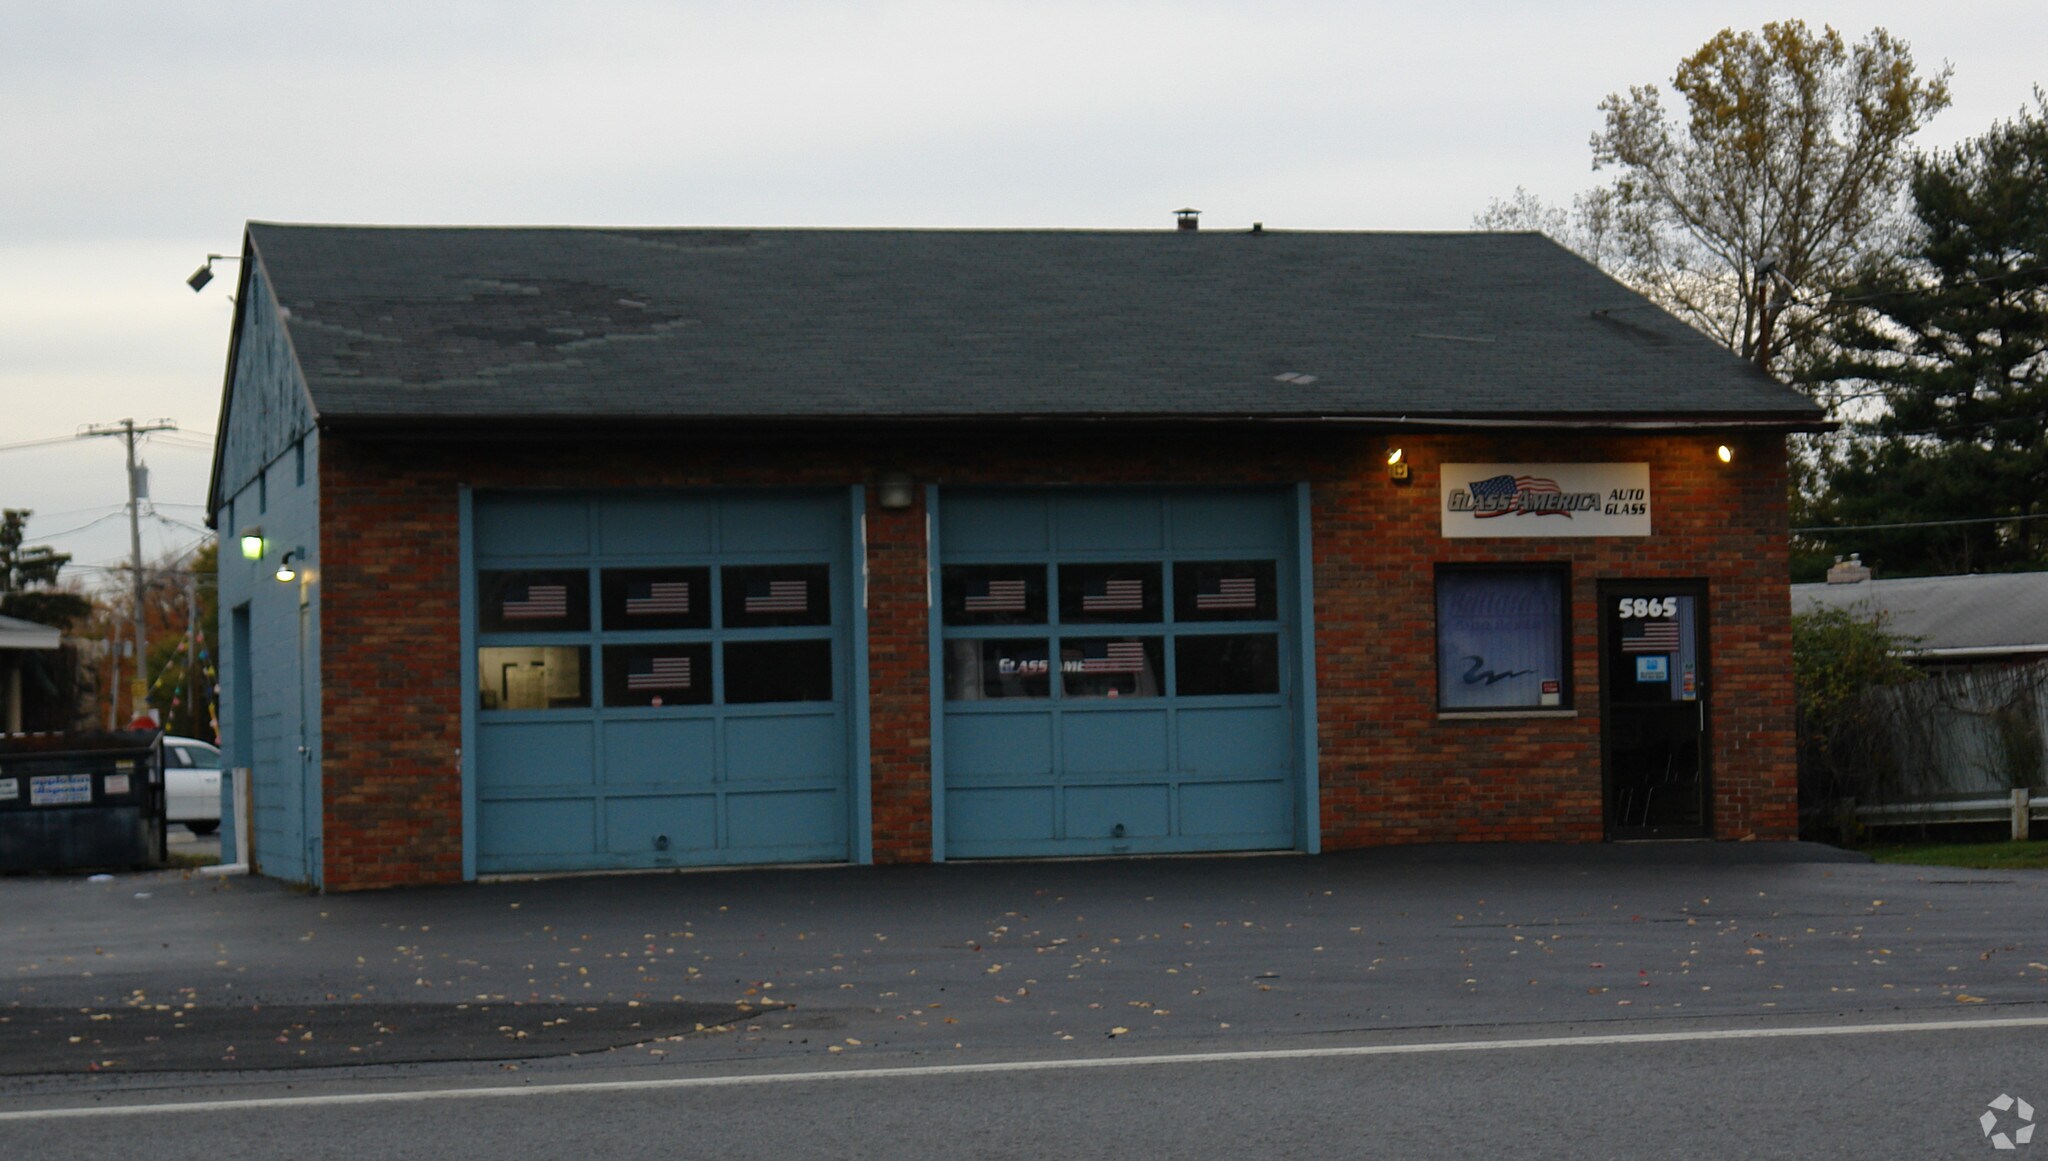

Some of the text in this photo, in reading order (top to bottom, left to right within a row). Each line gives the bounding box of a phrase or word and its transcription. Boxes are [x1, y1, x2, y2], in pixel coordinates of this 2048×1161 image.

[1448, 488, 1601, 512] GLASS AMERICA
[1609, 488, 1645, 501] AUTO
[1604, 502, 1647, 516] GLASS
[1619, 597, 1677, 619] 5865
